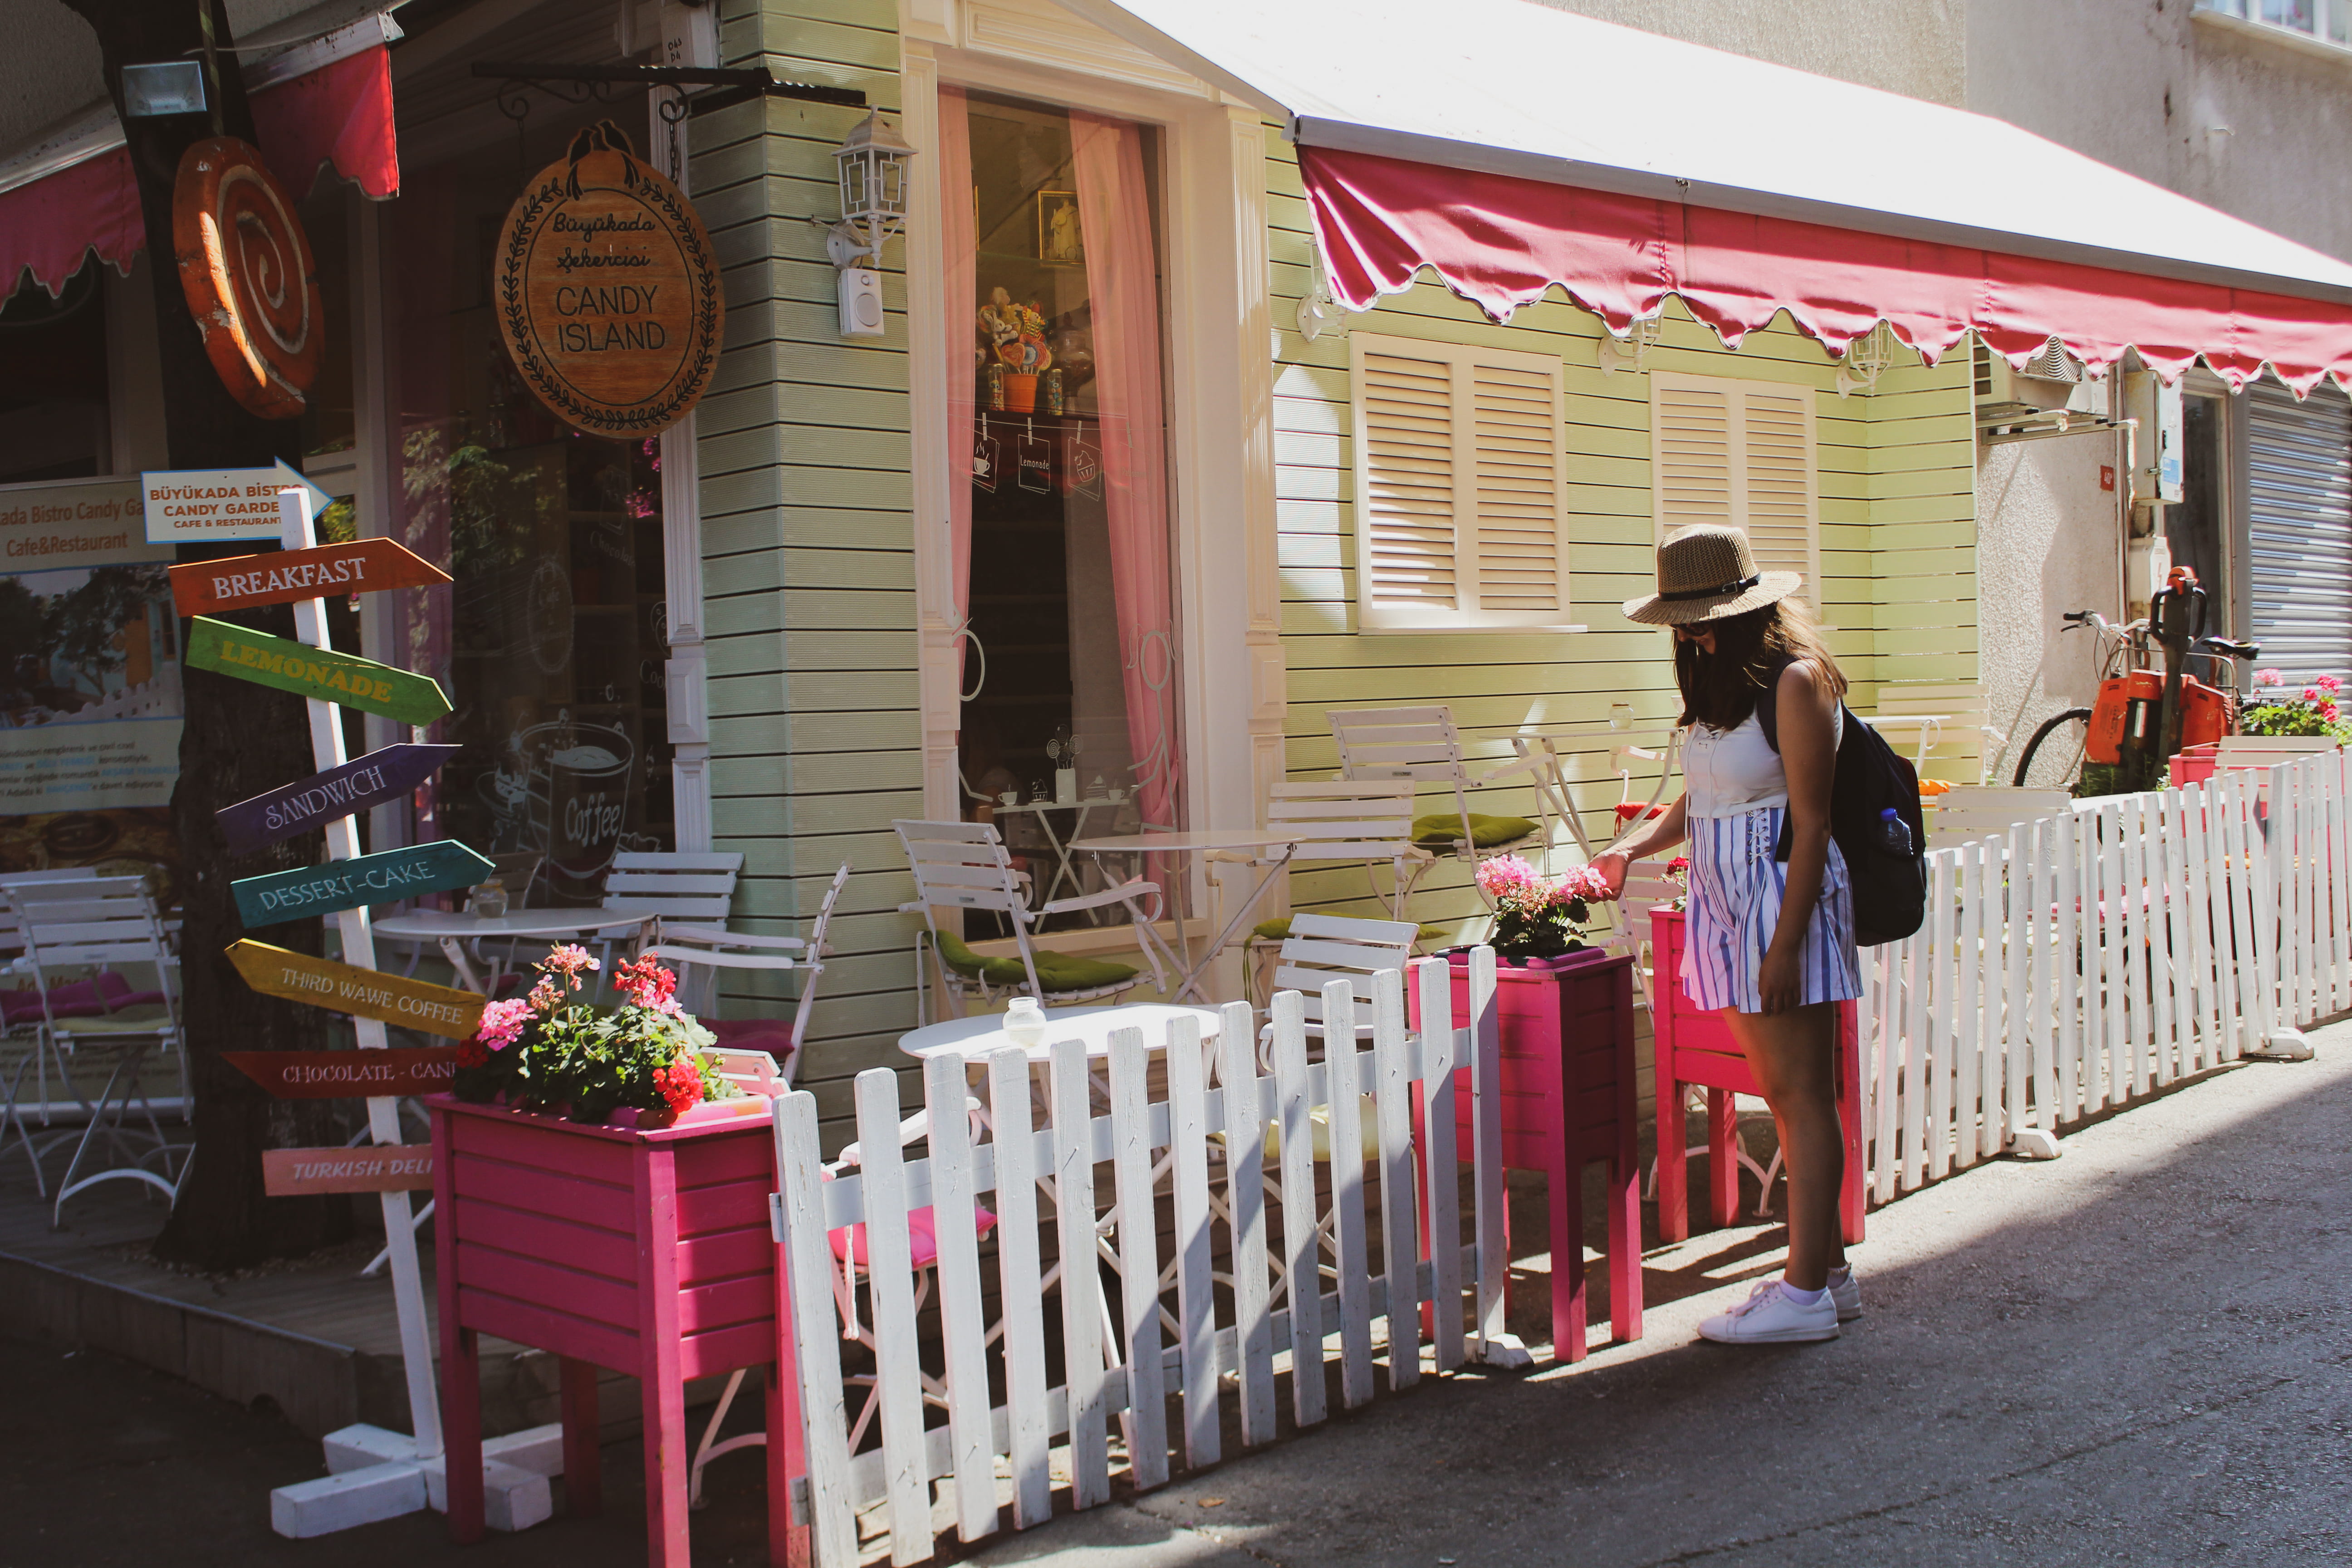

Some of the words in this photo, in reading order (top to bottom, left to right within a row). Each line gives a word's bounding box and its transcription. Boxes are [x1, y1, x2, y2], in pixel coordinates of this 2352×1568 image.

[552, 212, 656, 243] Büyükada
[556, 245, 651, 274] Şekercisi
[556, 284, 658, 317] CANDY
[558, 322, 666, 353] ISLAND
[1020, 454, 1049, 470] Lemonade
[150, 485, 240, 500] BÜYÜKADA
[31, 505, 73, 524] Bistro
[77, 499, 122, 521] Candy
[125, 498, 144, 516] Ga
[163, 504, 220, 517] CANDY
[225, 501, 279, 514] GARDE
[174, 519, 202, 529] CAFE
[6, 532, 128, 557] Cafe&Restaurant
[212, 557, 367, 599] BREAKFAST
[220, 640, 393, 703] LEMONADE
[639, 659, 666, 691] Coo
[265, 765, 387, 830] SANDWICH
[564, 792, 621, 848] Coffee
[282, 967, 334, 994] THIRD
[340, 981, 394, 1009] WAWE
[397, 995, 464, 1025] COFFEE
[283, 1064, 395, 1085] CHOCOLATE
[411, 1062, 456, 1079] CAN
[294, 1161, 382, 1180] TURKISH
[390, 1159, 433, 1176] DELI
